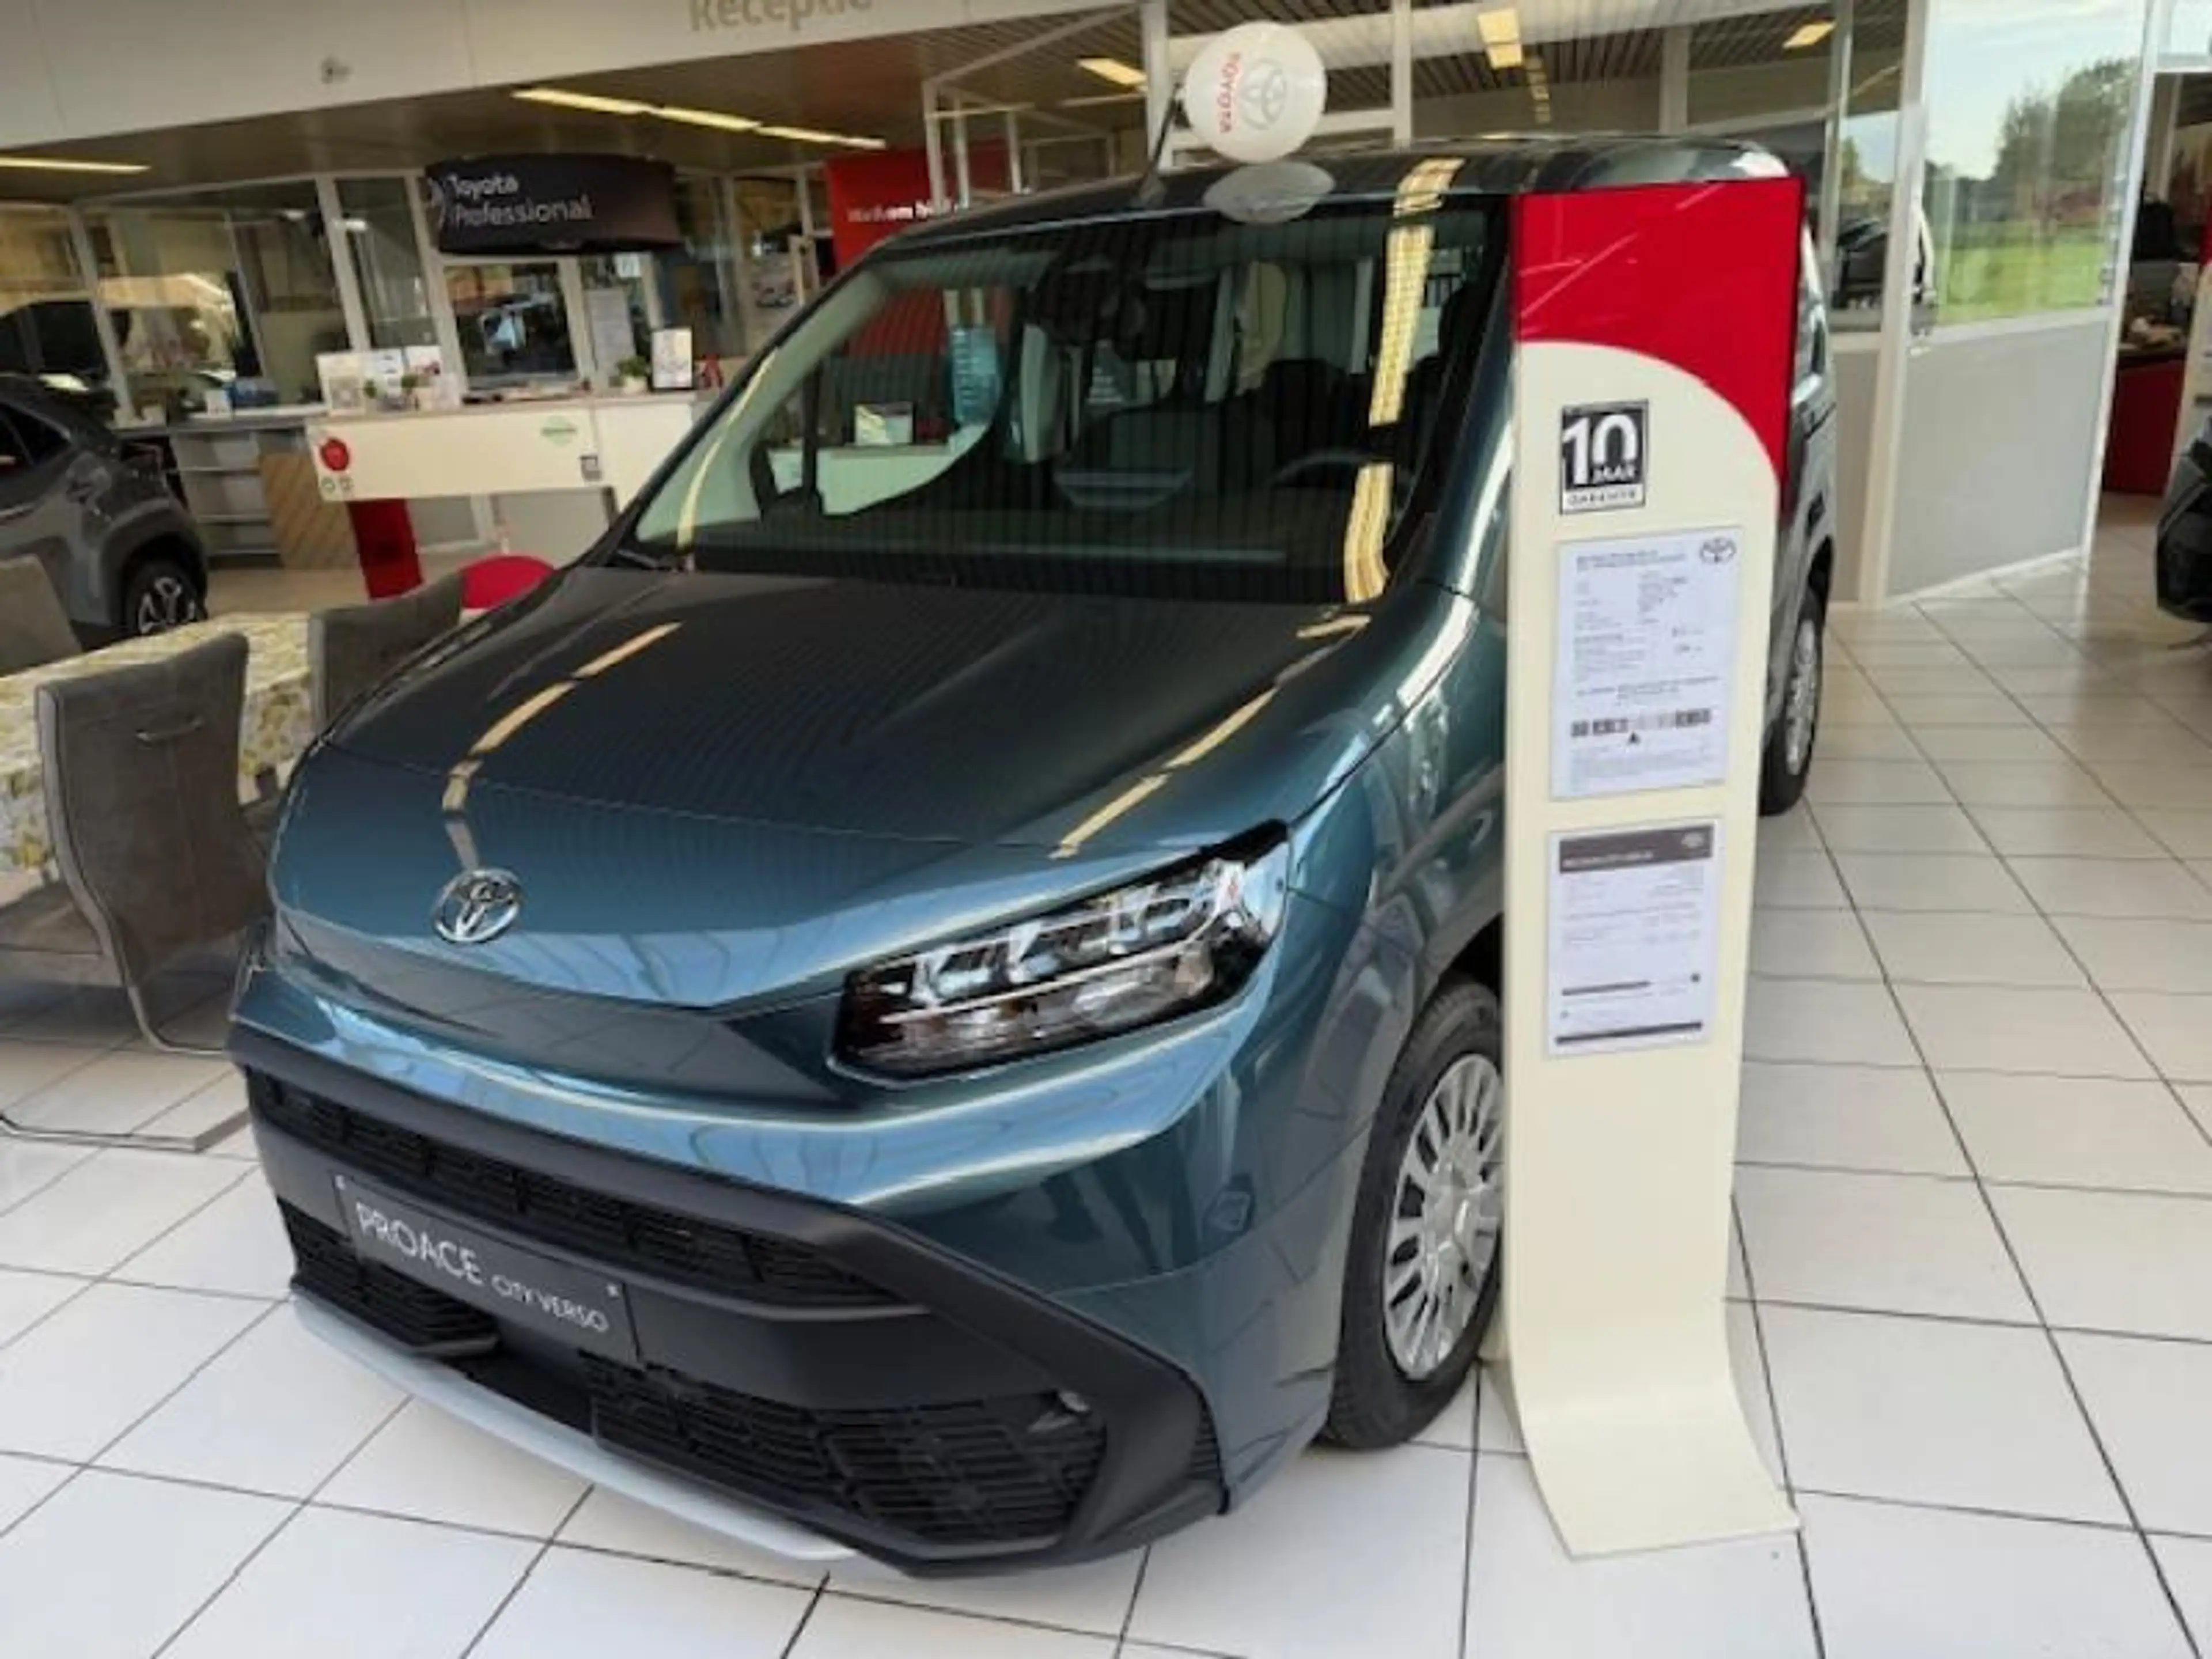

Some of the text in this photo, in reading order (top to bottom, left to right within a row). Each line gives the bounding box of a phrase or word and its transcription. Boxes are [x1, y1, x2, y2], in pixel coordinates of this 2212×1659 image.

[1217, 52, 1241, 133] TOYOTA
[448, 172, 518, 200] Toyota
[1563, 414, 1638, 485] 10
[355, 1201, 485, 1286] PROACE
[536, 1288, 609, 1332] VERSO
